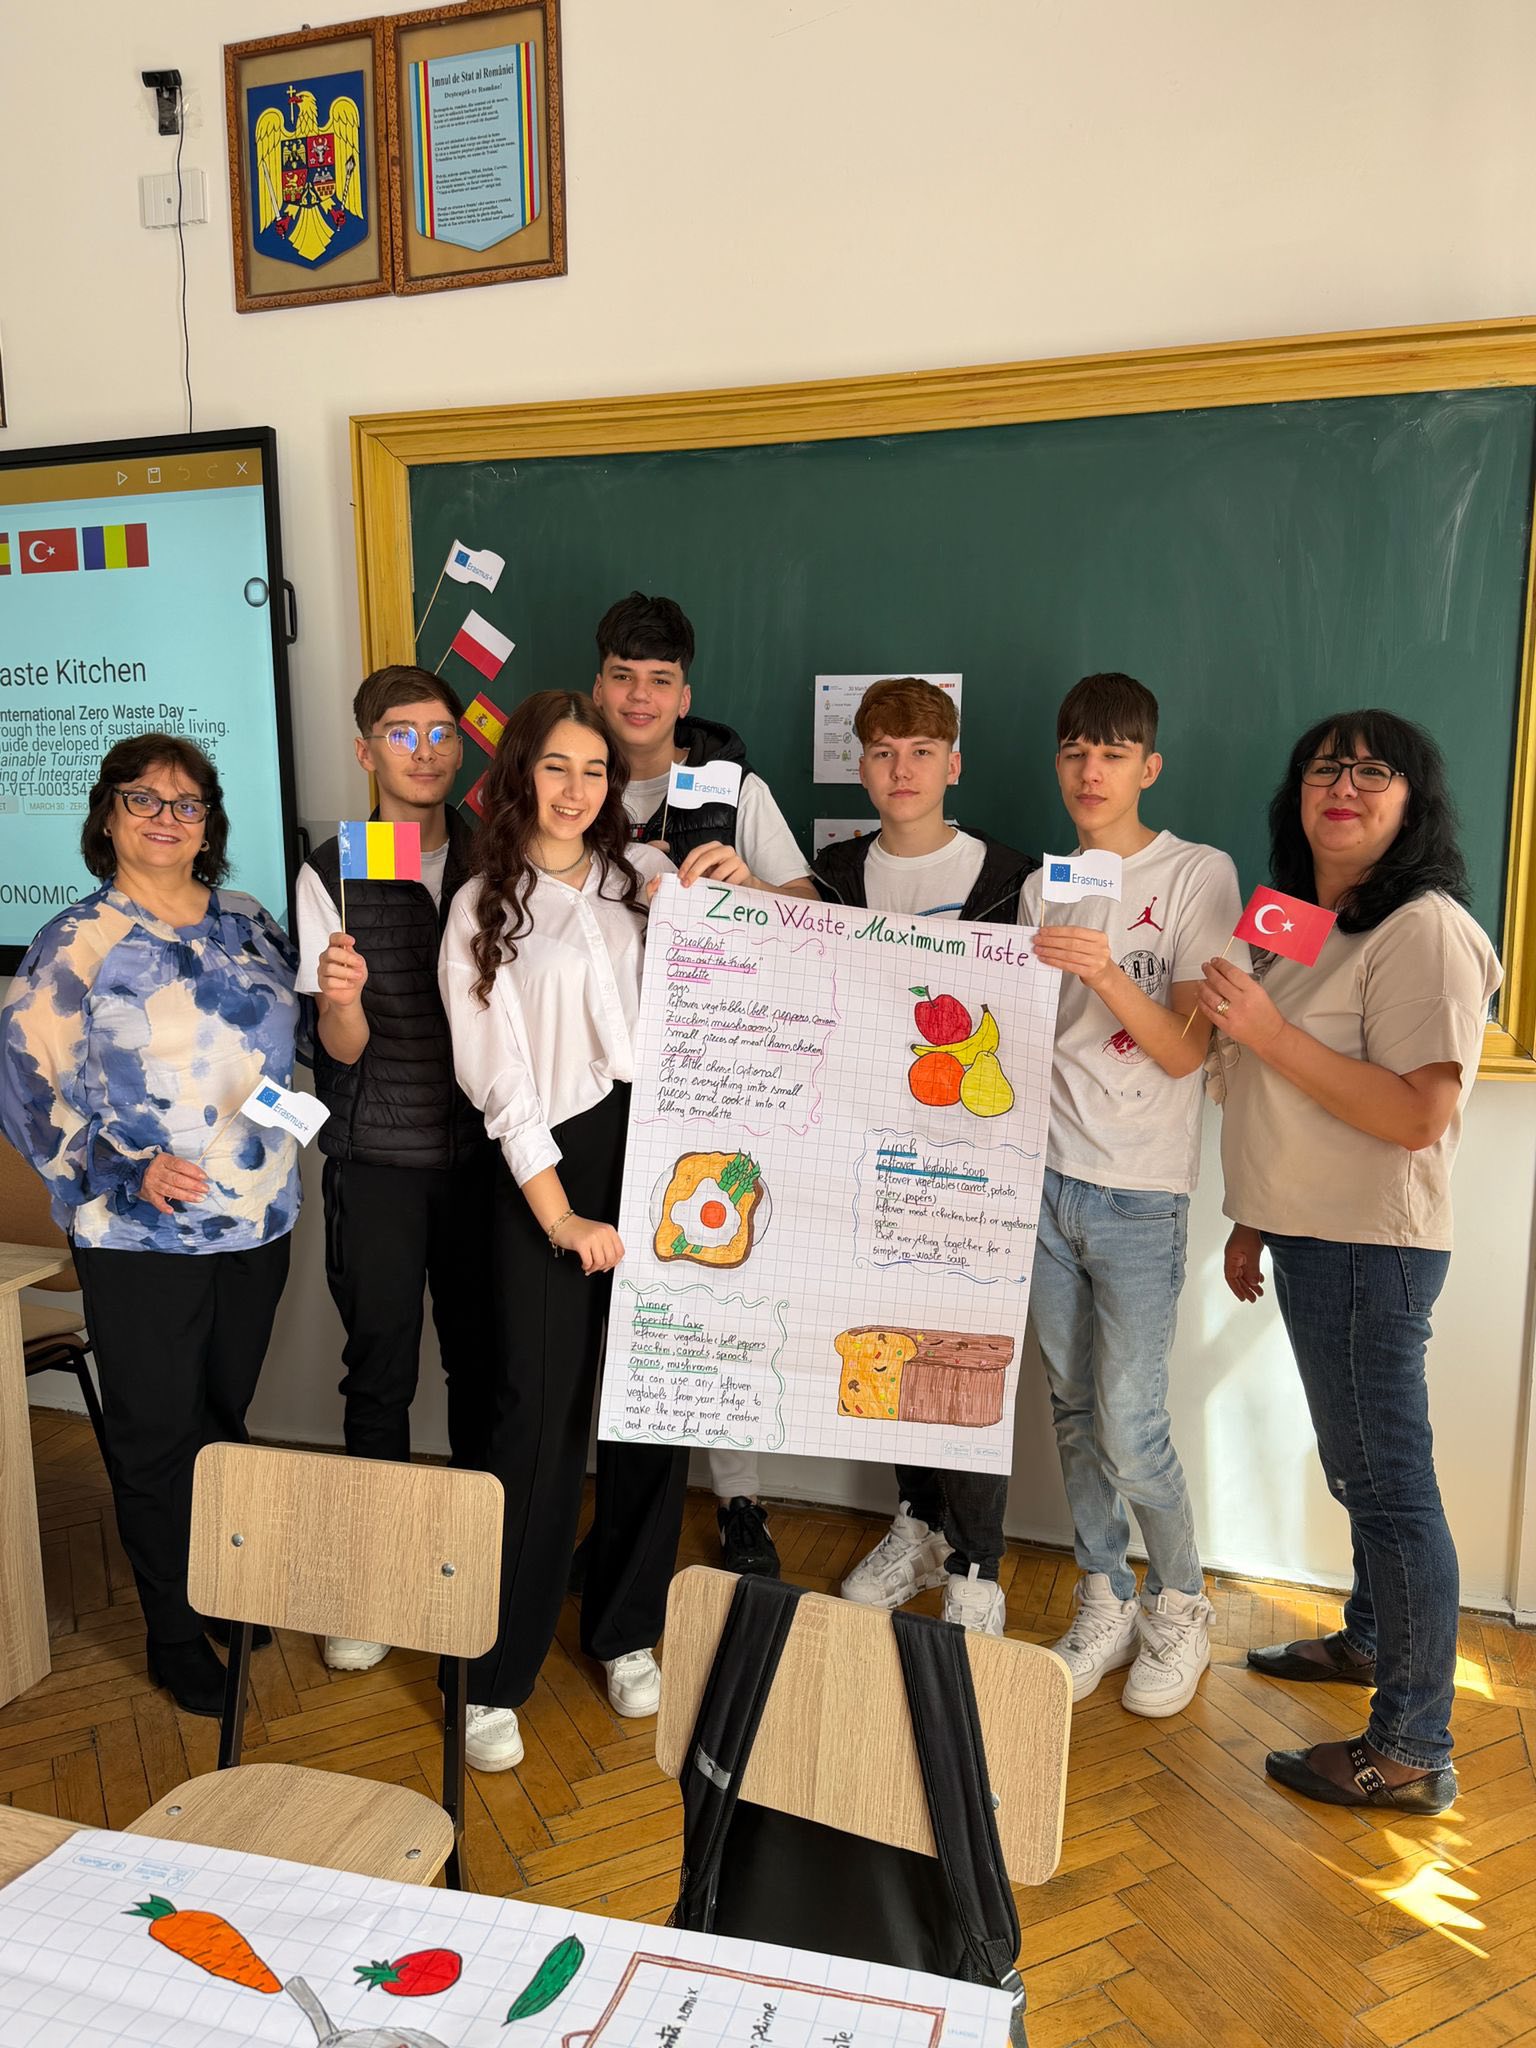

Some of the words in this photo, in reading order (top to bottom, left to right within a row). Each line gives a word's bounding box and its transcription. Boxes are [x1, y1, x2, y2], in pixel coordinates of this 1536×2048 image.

[431, 74, 451, 87] Imnul
[452, 73, 460, 84] de
[461, 71, 475, 82] Stat
[475, 69, 482, 79] al
[483, 63, 514, 79] României
[467, 562, 493, 581] Erasmus+
[56, 657, 147, 685] Kitchen
[79, 706, 109, 720] Zero
[112, 704, 155, 719] Waste
[159, 703, 184, 720] Day
[36, 722, 56, 736] the
[59, 722, 87, 736] lens
[90, 721, 103, 735] of
[108, 718, 185, 735] sustainable
[189, 719, 230, 737] living.
[33, 736, 99, 753] developed
[51, 751, 103, 767] Tourism
[21, 768, 36, 781] of
[694, 782, 732, 795] Erasmus+
[1072, 873, 1114, 888] Erasmus+
[705, 886, 769, 926] Zero
[774, 899, 851, 940] Waste,
[854, 915, 966, 957] Maximum
[970, 931, 1029, 967] Taste
[672, 929, 725, 954] Breakfast
[667, 963, 710, 980] Omelette
[668, 982, 690, 998] eggs
[701, 998, 746, 1014] vegetables
[728, 1035, 740, 1046] of
[741, 1036, 764, 1047] meat
[679, 1055, 703, 1071] little
[706, 1060, 732, 1074] cheese
[659, 1067, 687, 1087] Chop
[691, 1075, 743, 1094] everything
[747, 1080, 768, 1092] into
[770, 1083, 803, 1097] small
[657, 1086, 691, 1101] pieces
[695, 1090, 718, 1104] and
[722, 1095, 745, 1106] cook
[755, 1097, 774, 1109] into
[778, 1101, 786, 1109] a
[273, 1103, 309, 1132] Erasmus+
[657, 1099, 685, 1117] filling
[689, 1106, 732, 1120] omelette
[877, 1137, 917, 1155] Lunch
[962, 1161, 986, 1181] Soup
[877, 1171, 912, 1188] leftover
[915, 1176, 956, 1195] vegetables
[876, 1197, 905, 1216] leftover
[909, 1207, 929, 1217] meat
[876, 1227, 894, 1240] Boil
[897, 1234, 940, 1252] everything
[944, 1233, 982, 1254] together
[986, 1240, 1001, 1257] for
[902, 1251, 942, 1261] no-waste
[635, 1292, 673, 1311] Dinner
[683, 1314, 705, 1330] Cake
[634, 1325, 668, 1340] leftover
[737, 1340, 767, 1351] peppers
[667, 1358, 719, 1374] mushrooms
[630, 1368, 644, 1381] You
[649, 1375, 665, 1384] can
[670, 1376, 689, 1386] use
[695, 1379, 714, 1391] any
[720, 1374, 752, 1392] leftover
[674, 1386, 693, 1405] from
[694, 1395, 715, 1407] your
[720, 1391, 745, 1411] fridge
[754, 1393, 762, 1406] to
[626, 1405, 651, 1415] make
[656, 1401, 669, 1416] the
[672, 1409, 695, 1422] recipe
[699, 1411, 721, 1420] more
[726, 1411, 760, 1423] creative
[625, 1418, 642, 1429] and
[648, 1420, 677, 1432] reduce
[682, 1419, 701, 1436] food
